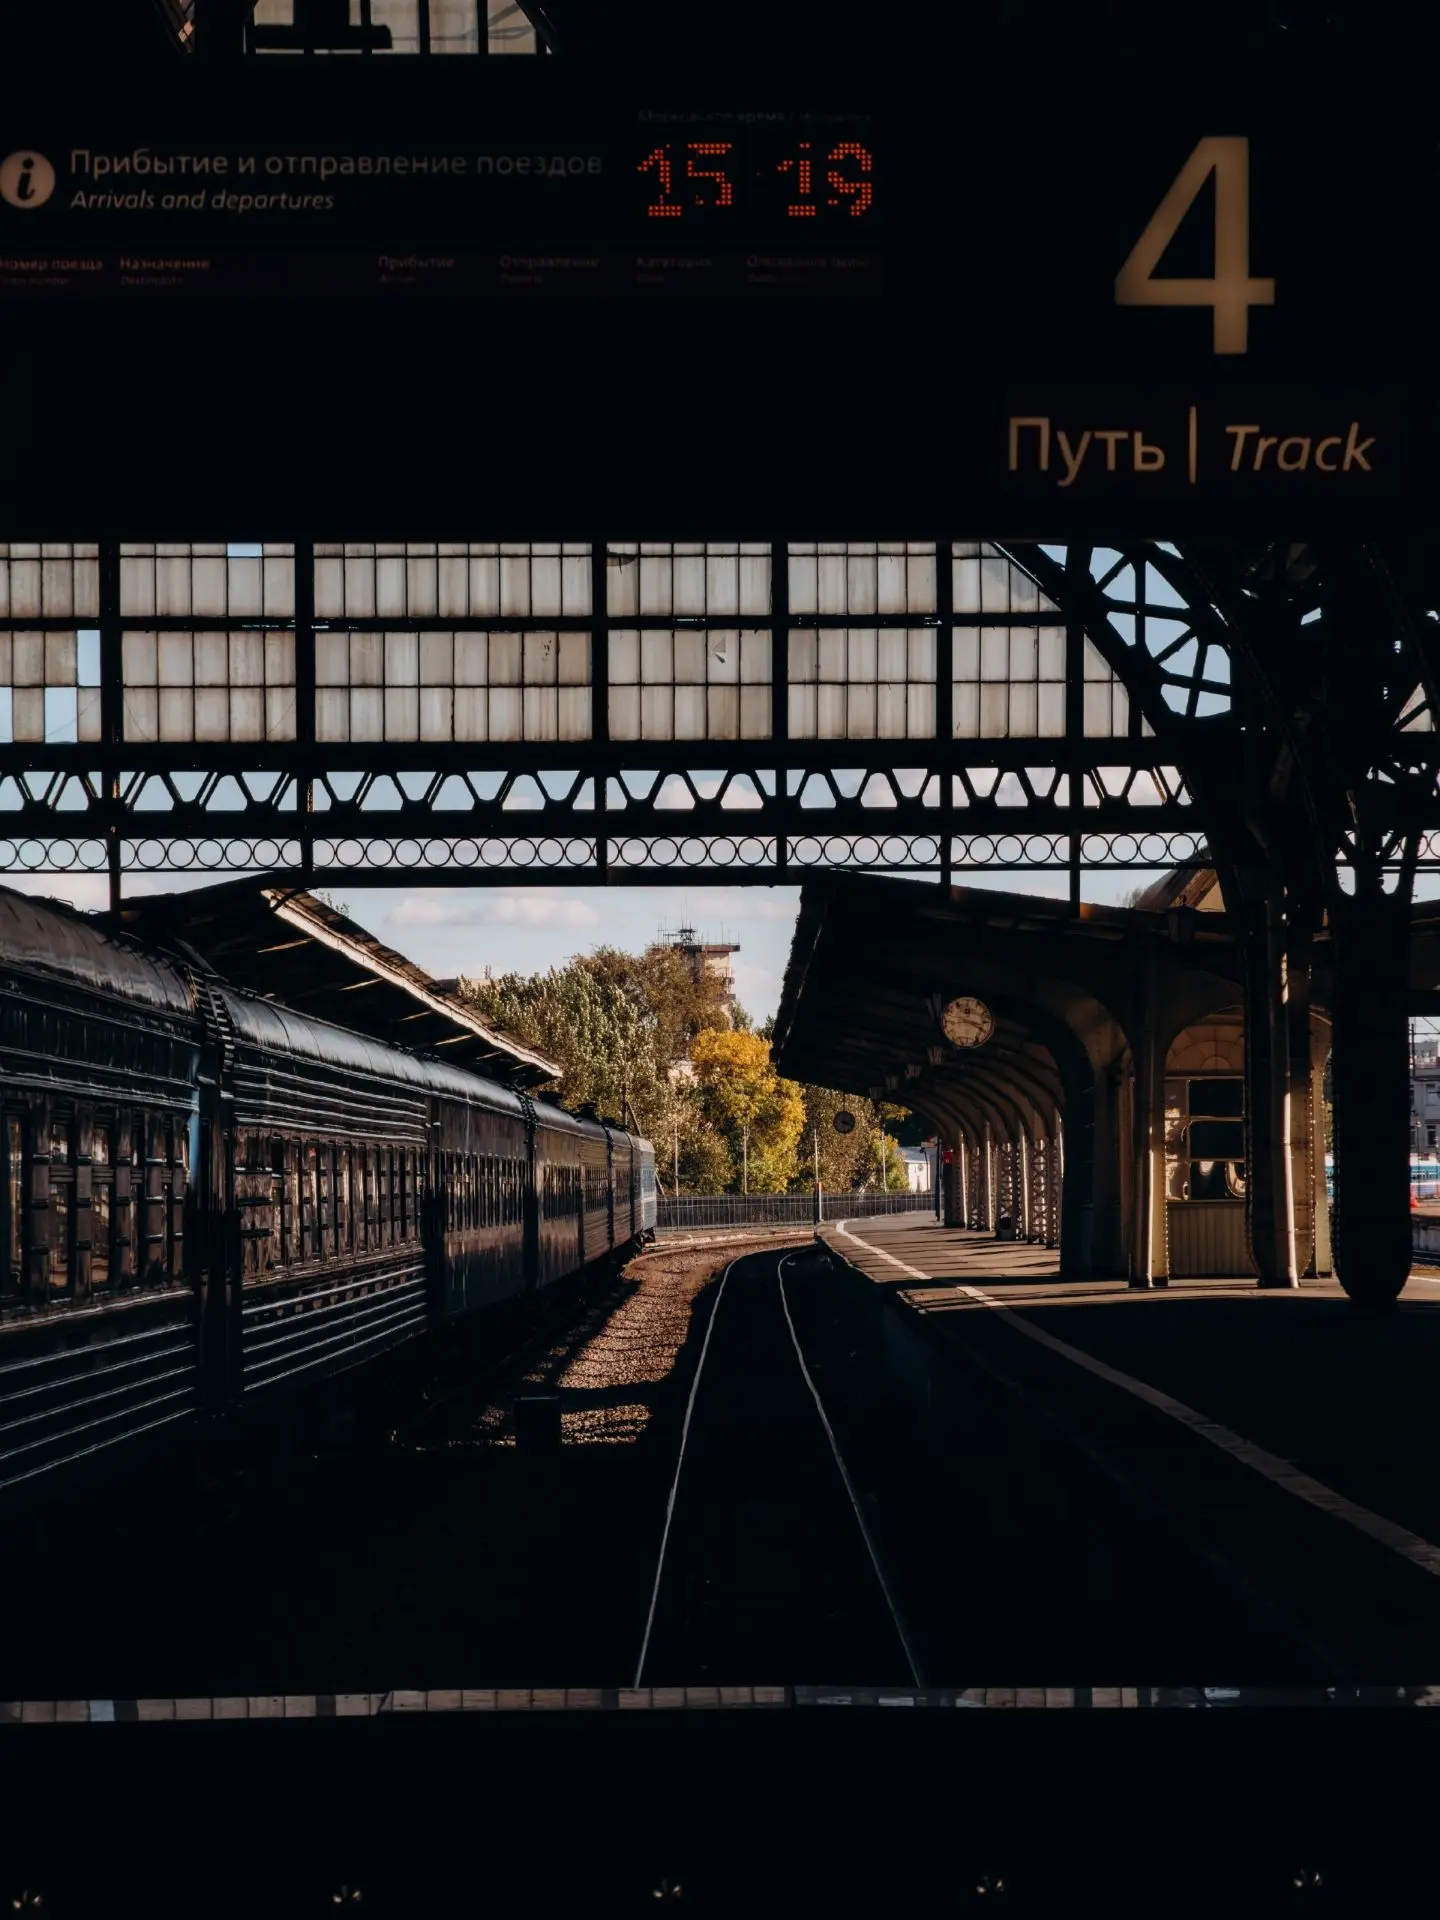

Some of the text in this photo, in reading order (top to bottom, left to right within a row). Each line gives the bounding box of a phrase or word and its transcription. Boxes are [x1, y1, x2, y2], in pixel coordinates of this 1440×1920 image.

[70, 148, 603, 181] Прибытие и отправление поездов
[636, 143, 873, 217] 15 19
[70, 189, 334, 214] Arrivals and departures
[1115, 135, 1275, 354] 4
[1008, 416, 1377, 487] Путь Track
